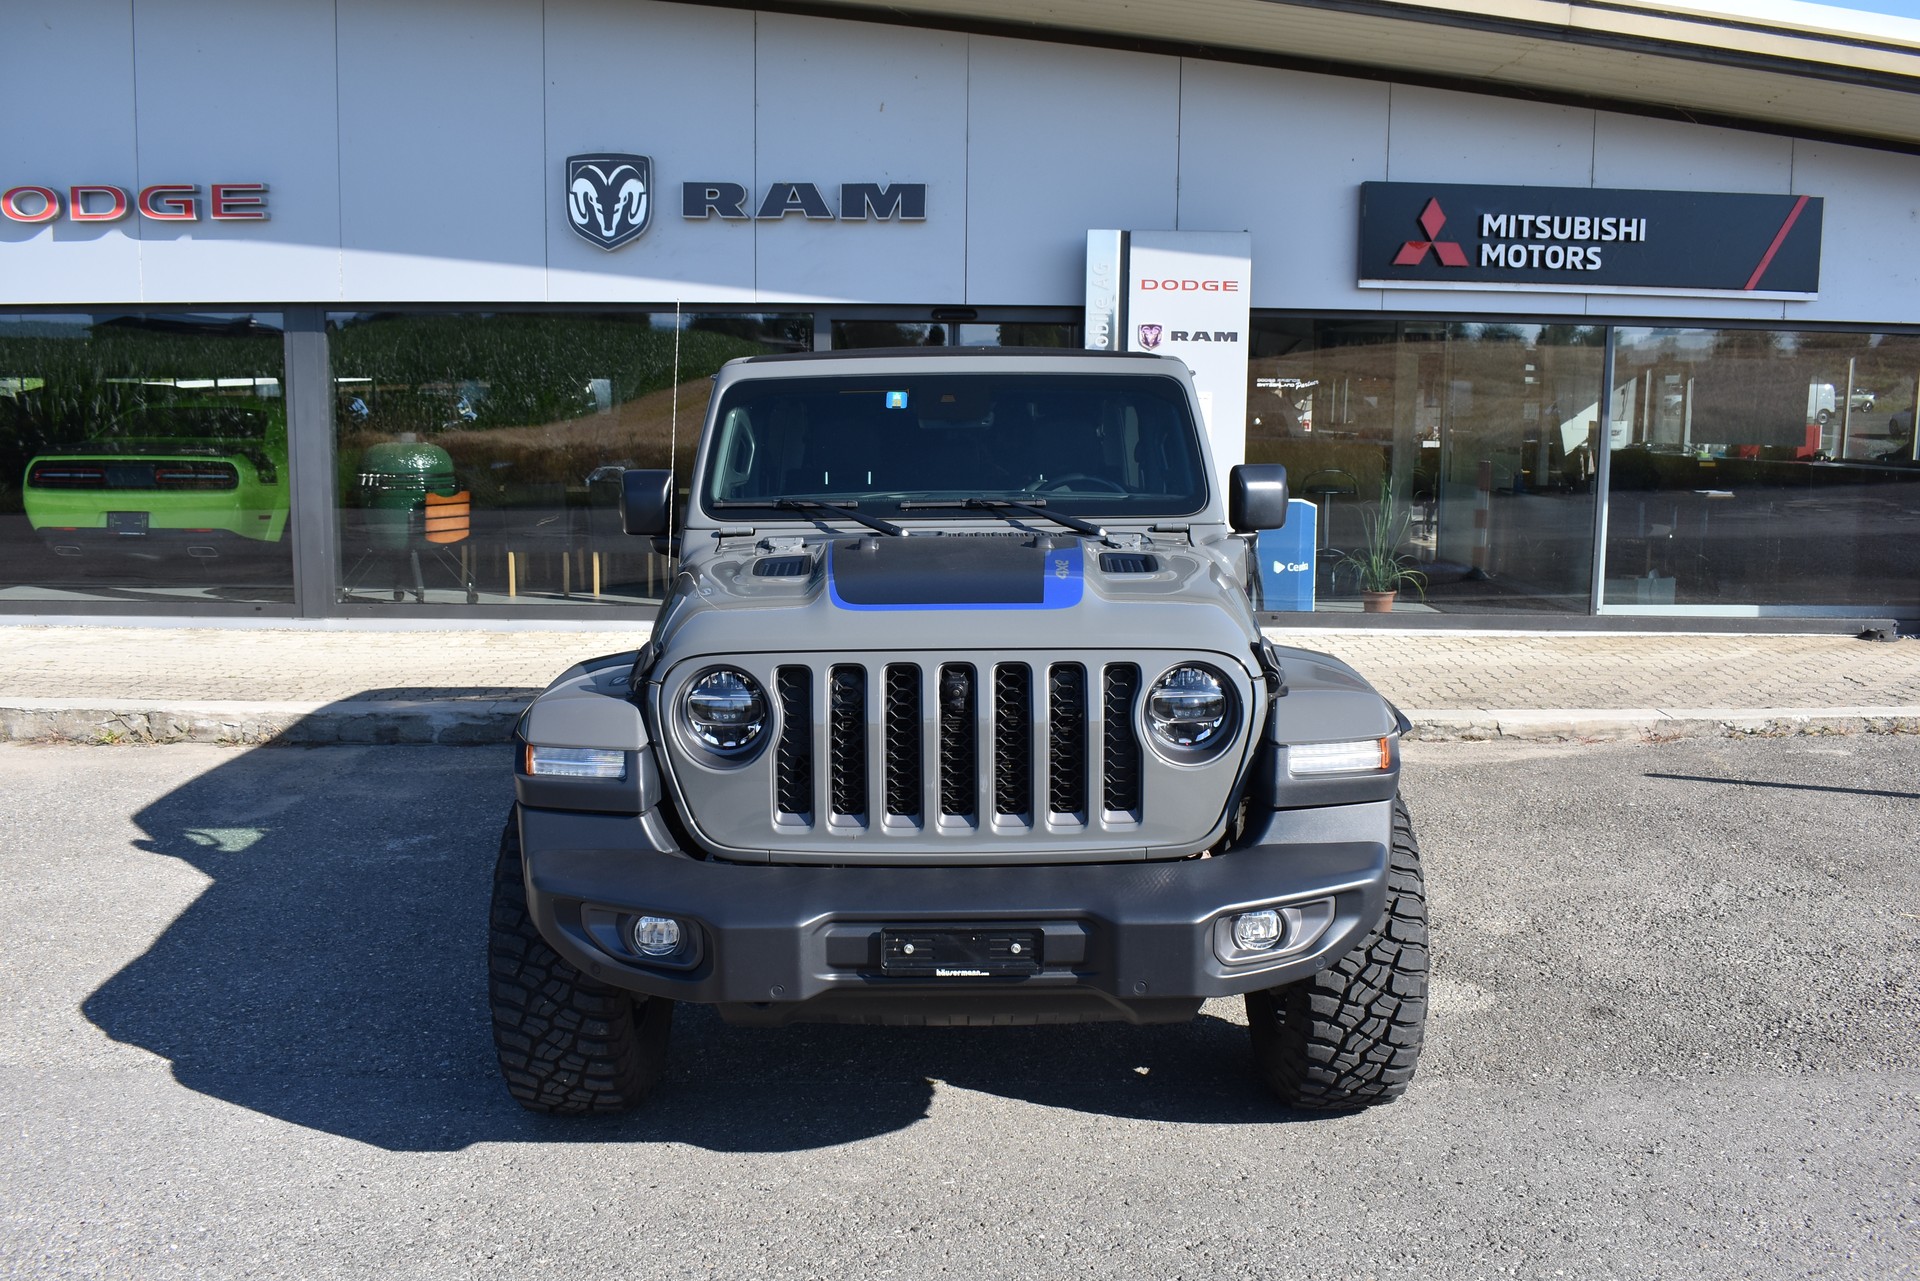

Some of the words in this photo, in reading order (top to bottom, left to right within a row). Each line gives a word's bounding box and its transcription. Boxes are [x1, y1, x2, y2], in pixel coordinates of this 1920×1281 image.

[682, 181, 928, 220] RAM
[1481, 213, 1647, 242] MITSUBISHI
[1480, 243, 1602, 270] MOTORS
[1141, 279, 1238, 291] DODGE
[1170, 330, 1238, 342] RAM
